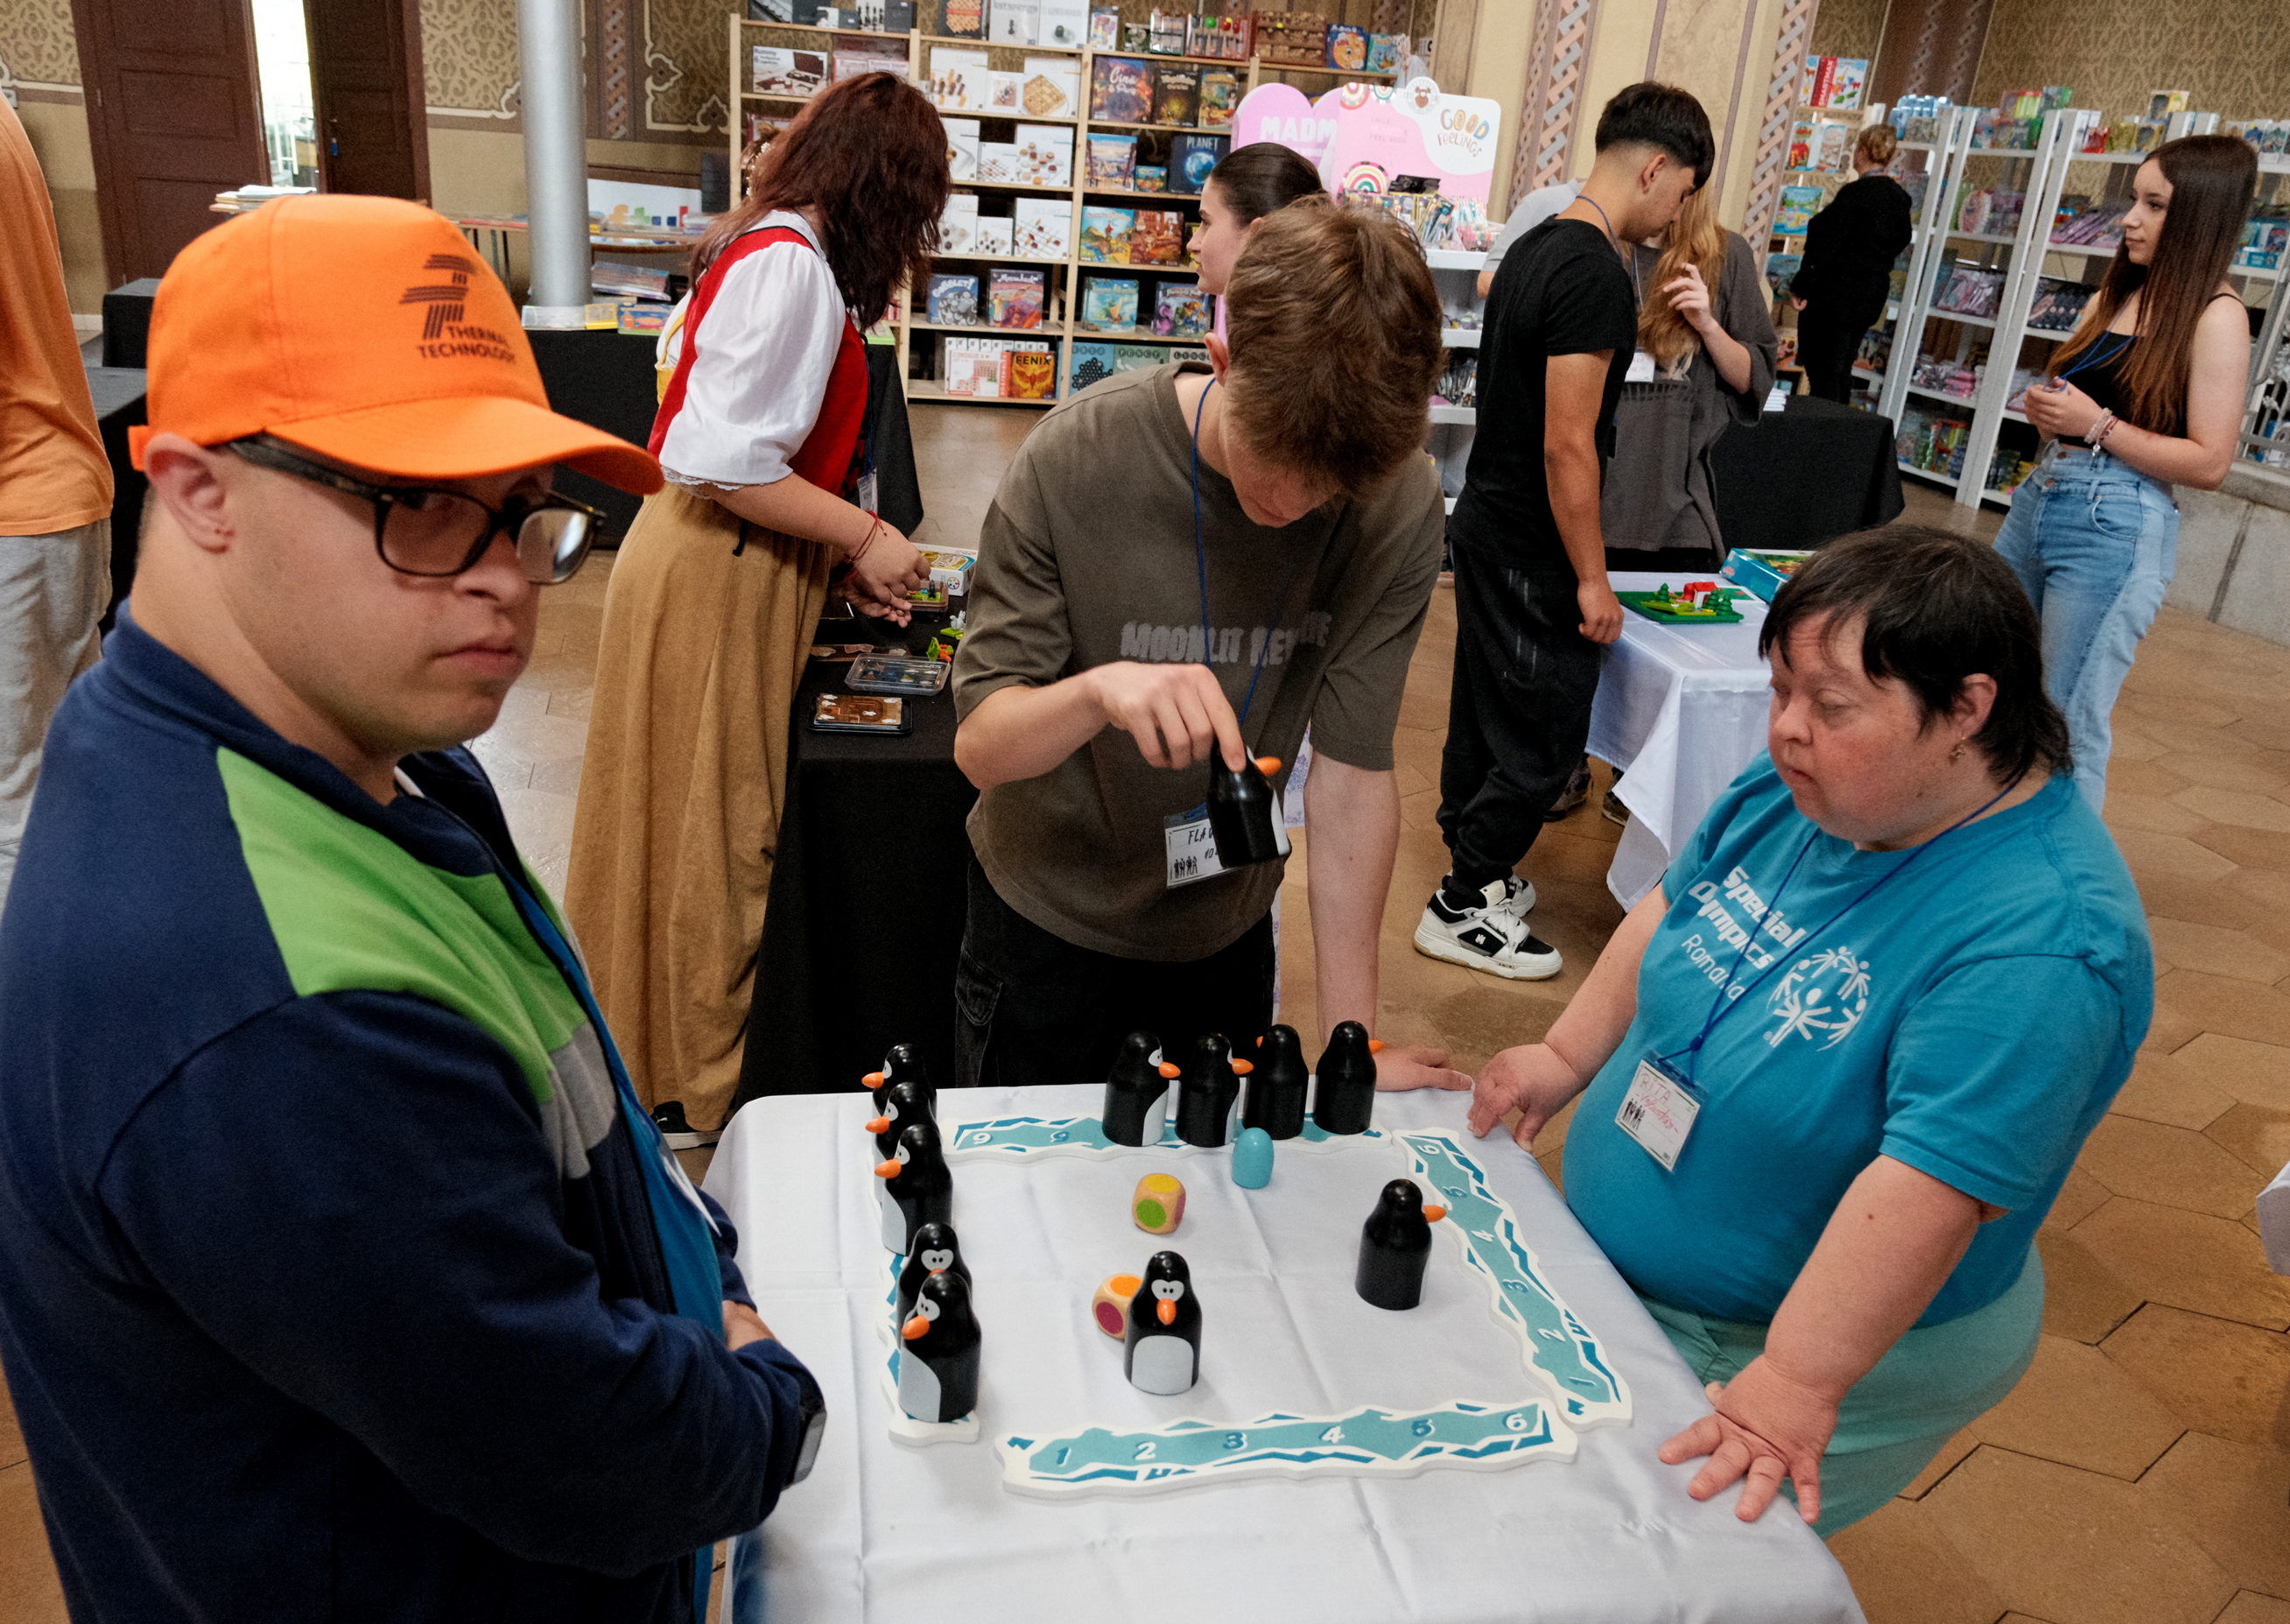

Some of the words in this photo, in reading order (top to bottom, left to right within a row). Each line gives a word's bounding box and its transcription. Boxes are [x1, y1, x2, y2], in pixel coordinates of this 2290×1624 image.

[1440, 108, 1490, 140] GOOD
[1186, 135, 1219, 151] PLANET
[1015, 355, 1051, 366] FENIX
[1120, 621, 1244, 664] MOONLIT
[1723, 866, 1808, 949] Special
[1681, 933, 1748, 1002] Romania
[1472, 1227, 1496, 1243] 4
[1502, 1278, 1529, 1294] 3
[1538, 1326, 1566, 1342] 2
[1055, 1445, 1071, 1468] 1
[1134, 1441, 1157, 1461] 2
[1222, 1430, 1249, 1452] 3
[1320, 1424, 1347, 1445] 4
[1411, 1417, 1437, 1439] 5
[1501, 1410, 1526, 1433] 6
